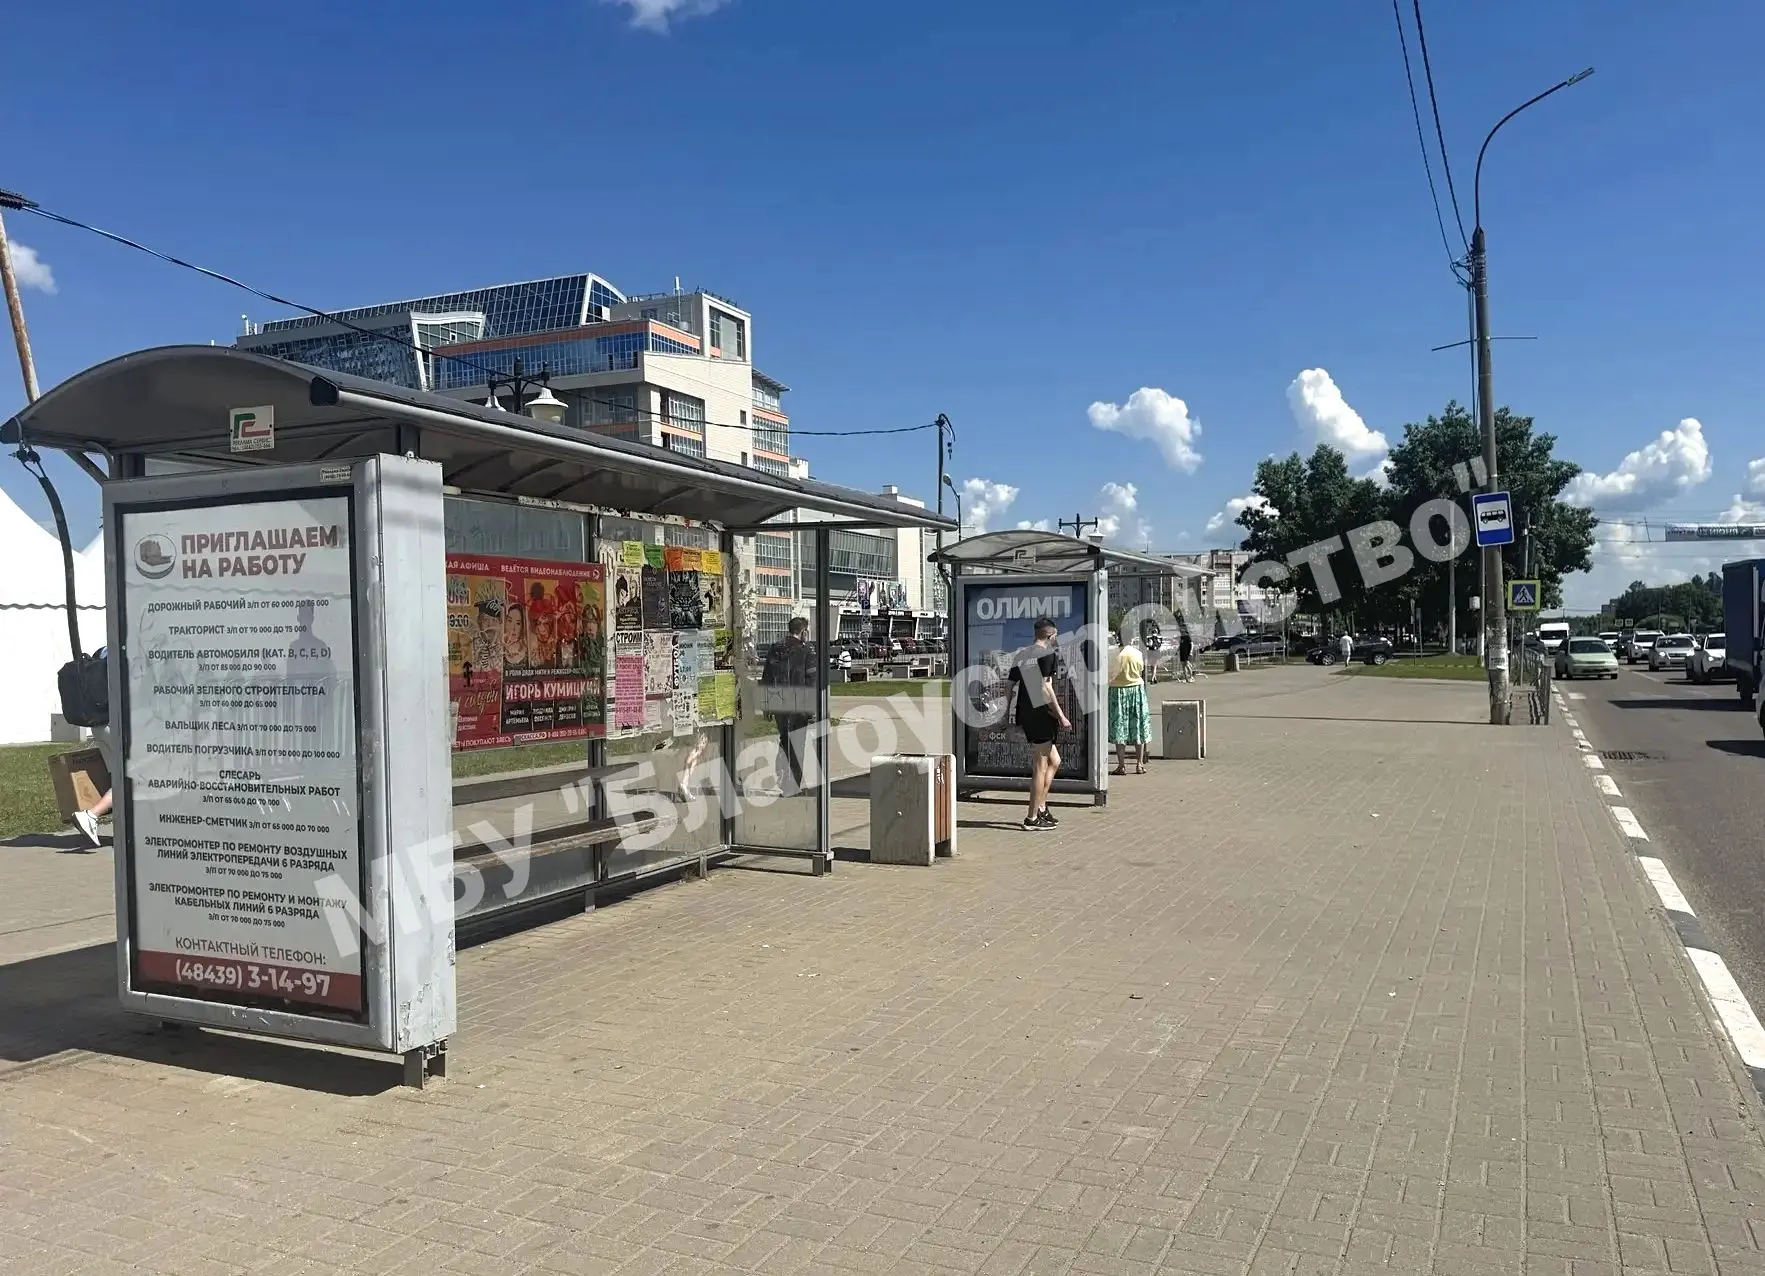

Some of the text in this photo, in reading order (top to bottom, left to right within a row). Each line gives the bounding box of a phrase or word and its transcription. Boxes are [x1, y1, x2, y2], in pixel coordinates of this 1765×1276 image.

[181, 525, 338, 555] ПРИГЛАШАЕМ
[182, 553, 306, 579] НА РАБОТУ
[460, 562, 490, 571] АФИША
[500, 564, 590, 577] ВЕДЁТСЯ ВИДЕОНАБЛЮДЕНИЕ
[148, 599, 201, 614] ДОРОЖНЫЙ
[204, 598, 246, 610] РАБОЧИЙ
[976, 596, 1071, 620] ОЛИМП
[168, 625, 224, 635] ТРАКТОРИСТ
[273, 626, 284, 634] ДО
[148, 650, 194, 661] ВОДИТЕЛЬ
[196, 648, 260, 659] АВТОМОБИЛЯ
[262, 648, 286, 659] (КАТ.
[154, 684, 326, 696] РАБОЧИЙ ЗЕЛЕНОГО СТРОИТЕЛЬСТВА
[506, 684, 541, 700] ИГОРЬ
[544, 677, 600, 698] КУМИЦКИЙ
[165, 720, 210, 731] ВАЛЬЩИК
[212, 722, 236, 731] ЛЕСА
[146, 744, 192, 754] ВОДИТЕЛЬ
[194, 746, 254, 756] ПОГРУЗЧИКА
[466, 738, 495, 746] ПОКУПАЮТ
[219, 770, 261, 780] СЛЕСАРЬ
[148, 778, 340, 796] АВАРИЙНО-ВОССТАНОВИТЕЛЬНЫХ РАБОТ
[160, 814, 248, 828] ИНЖЕНЕР-СМЕТЧИК
[296, 824, 306, 832] ДО
[145, 836, 348, 860] ЭЛЕКТРОМОНТЕР ПО РЕМОНТУ ВОЗДУШНЫХ
[158, 848, 335, 872] ЛИНИЙ ЭЛЕКТРОПЕРЕДАЧИ 6 РАЗРЯДА
[148, 882, 347, 909] ЭЛЕКТРОМОНТЕР ПО РЕМОНТУ И МОНТАЖУ
[174, 896, 320, 920] КАБЕЛЬНЫХ ЛИНИЙ 6 РАЗРЯДА
[253, 918, 263, 926] ДО
[176, 936, 327, 966] КОНТАКТНЫЙ ТЕЛЕФОН:
[176, 959, 330, 996] (48439) 3-14-97
